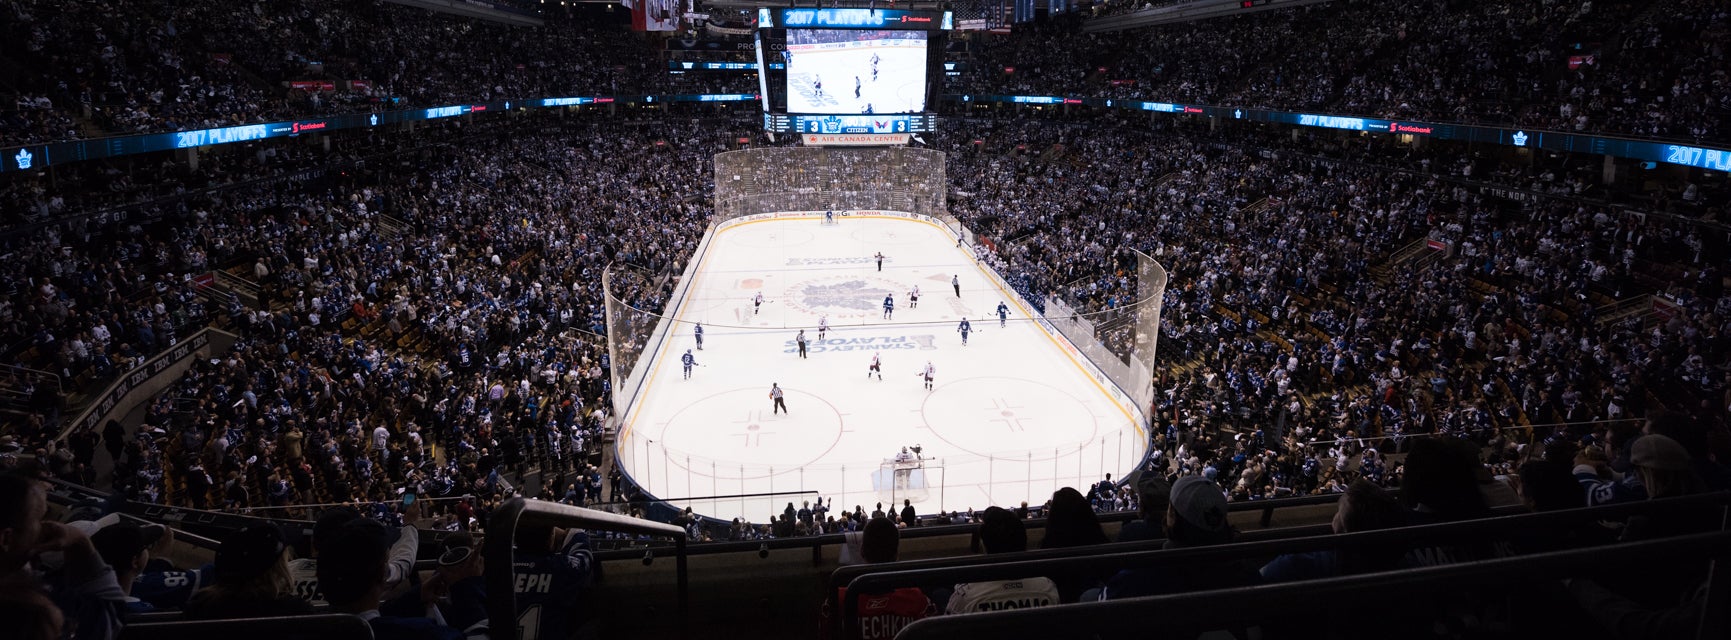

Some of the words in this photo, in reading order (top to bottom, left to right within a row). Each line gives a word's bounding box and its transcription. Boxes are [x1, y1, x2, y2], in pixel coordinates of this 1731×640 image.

[785, 11, 814, 25] 2017
[817, 11, 883, 25] PLAYOFFS
[810, 121, 818, 132] 3
[897, 121, 905, 132] 3
[1300, 115, 1319, 126] 2017
[1319, 116, 1364, 130] PLAYOFFS
[1398, 125, 1432, 134] Scotiabank
[177, 129, 206, 148] 2017
[209, 124, 267, 144] PLAYOFFS
[300, 122, 327, 131] Scotiabank
[1667, 144, 1703, 166] 2017
[193, 334, 207, 348] IBM
[174, 345, 189, 360] IBM
[154, 356, 170, 371] IBM
[131, 369, 148, 385] IBM
[102, 396, 114, 413] IBM
[87, 409, 100, 429] IBM
